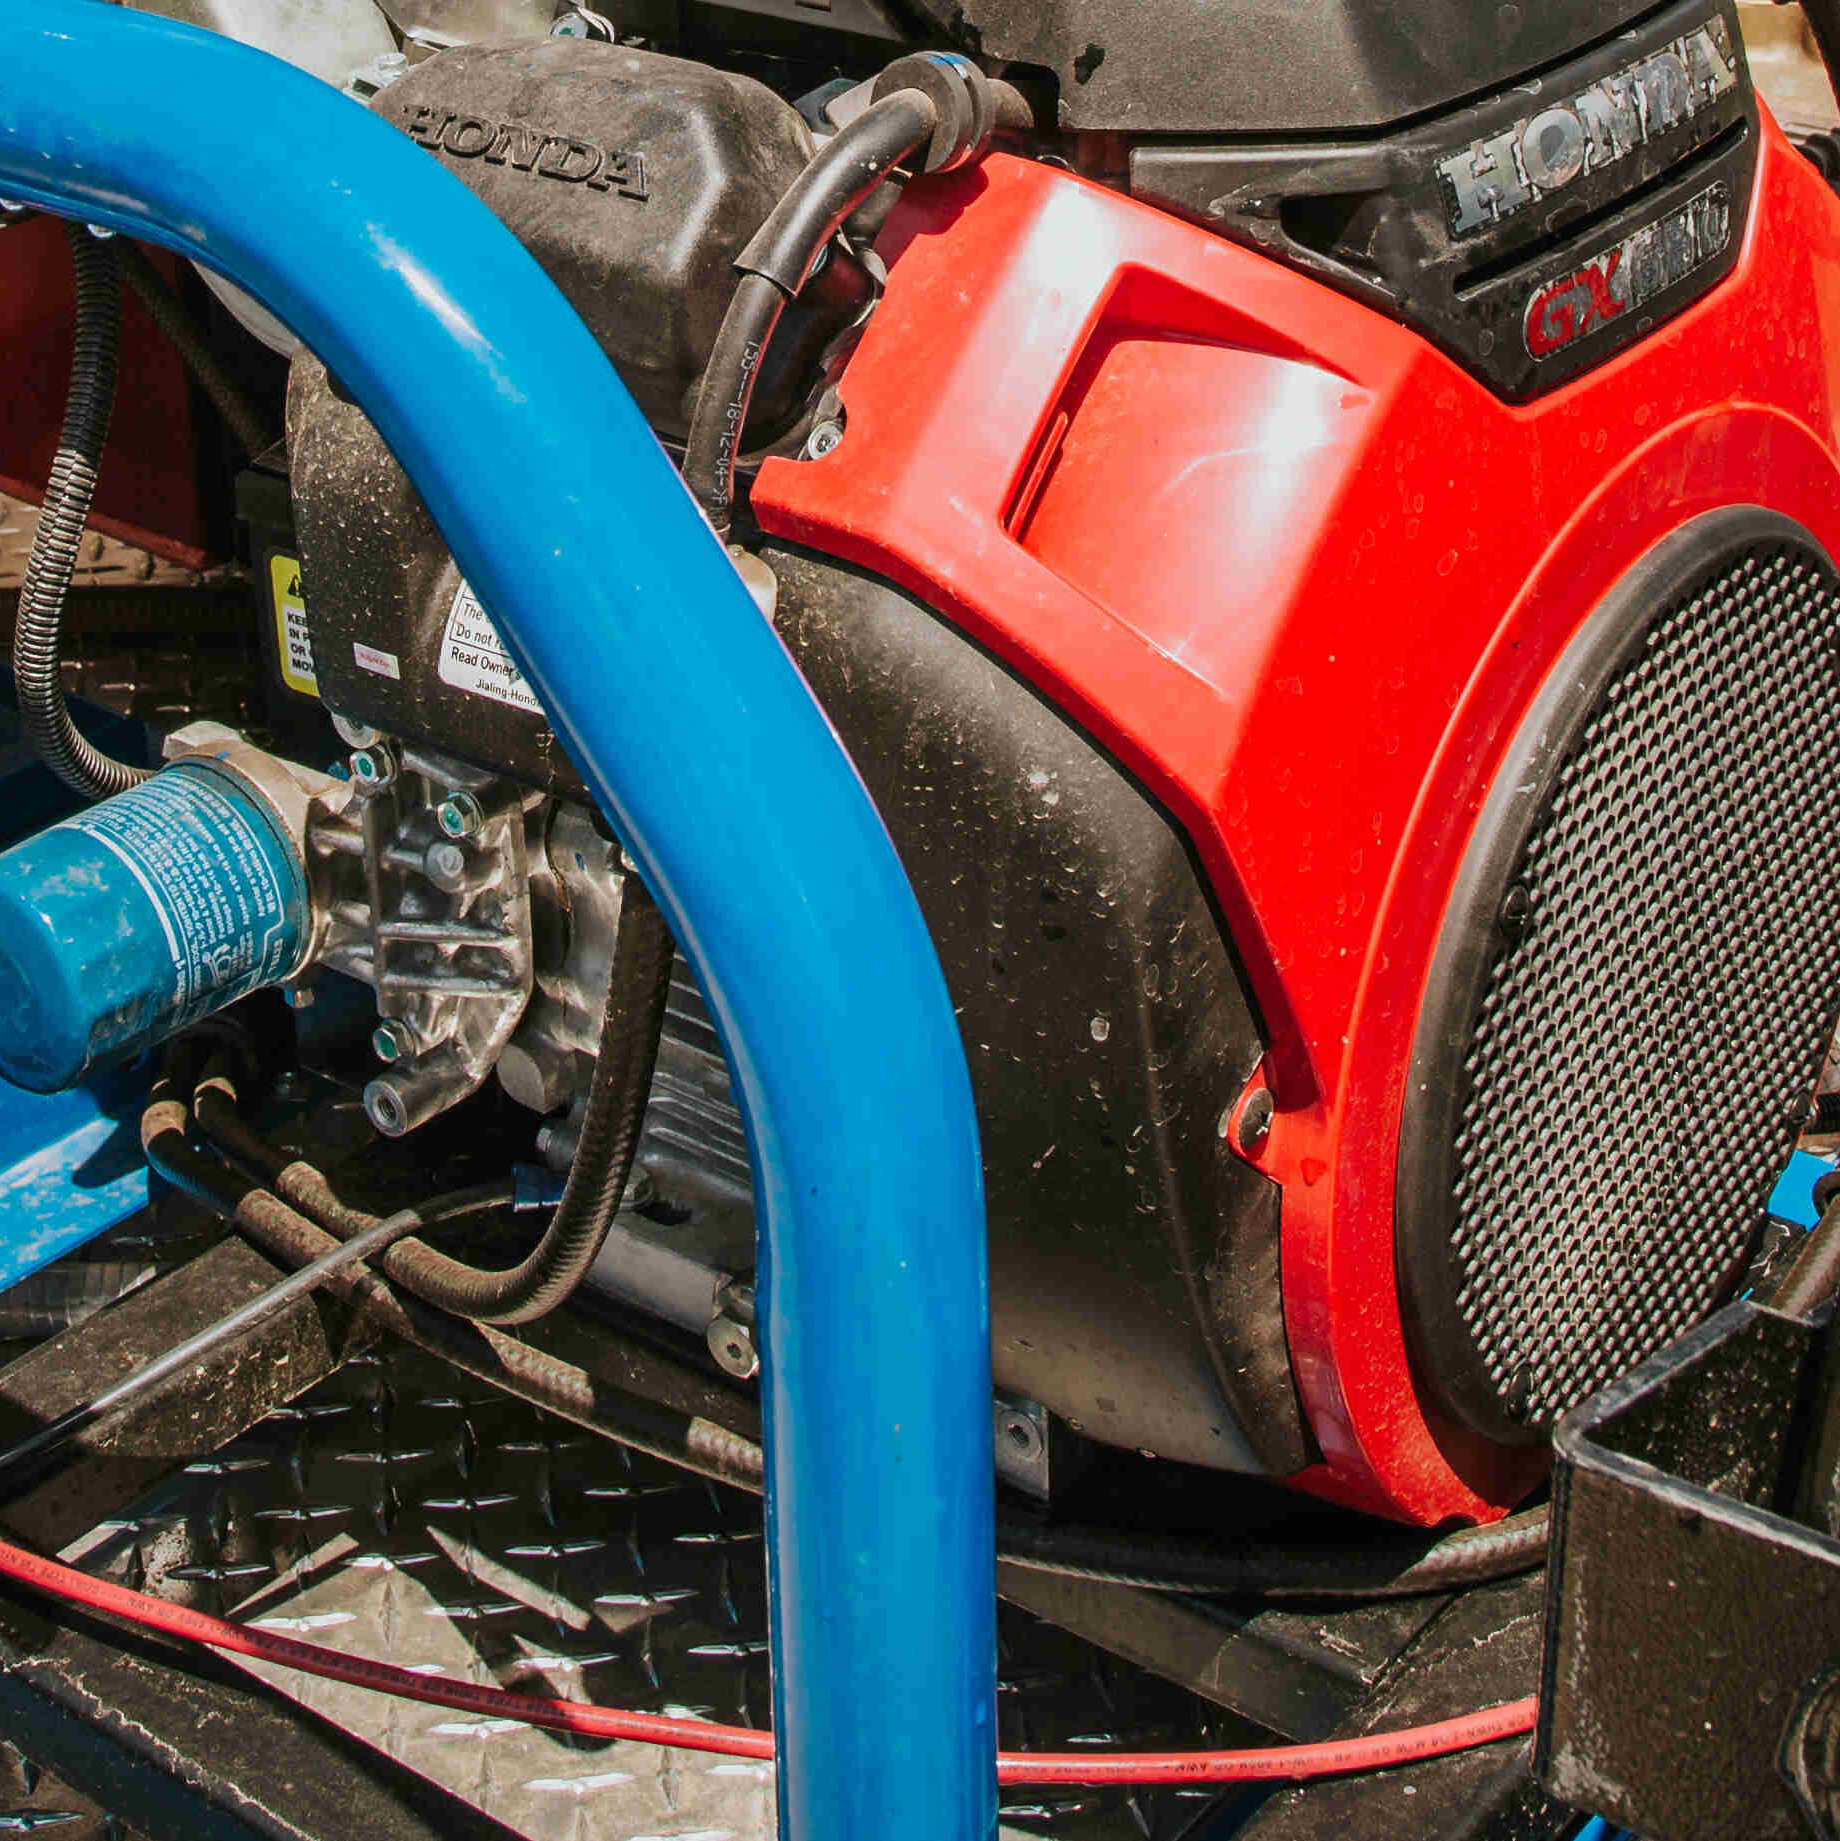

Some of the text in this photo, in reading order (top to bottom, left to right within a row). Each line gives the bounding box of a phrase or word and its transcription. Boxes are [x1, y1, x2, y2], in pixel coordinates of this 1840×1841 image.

[1435, 16, 1738, 236] HONDA
[402, 104, 650, 202] HONDA
[463, 603, 483, 621] The
[455, 623, 470, 639] Do
[474, 632, 492, 646] not
[290, 643, 307, 656] OR
[451, 646, 479, 667] Read
[476, 679, 538, 706] Jialing-Hond
